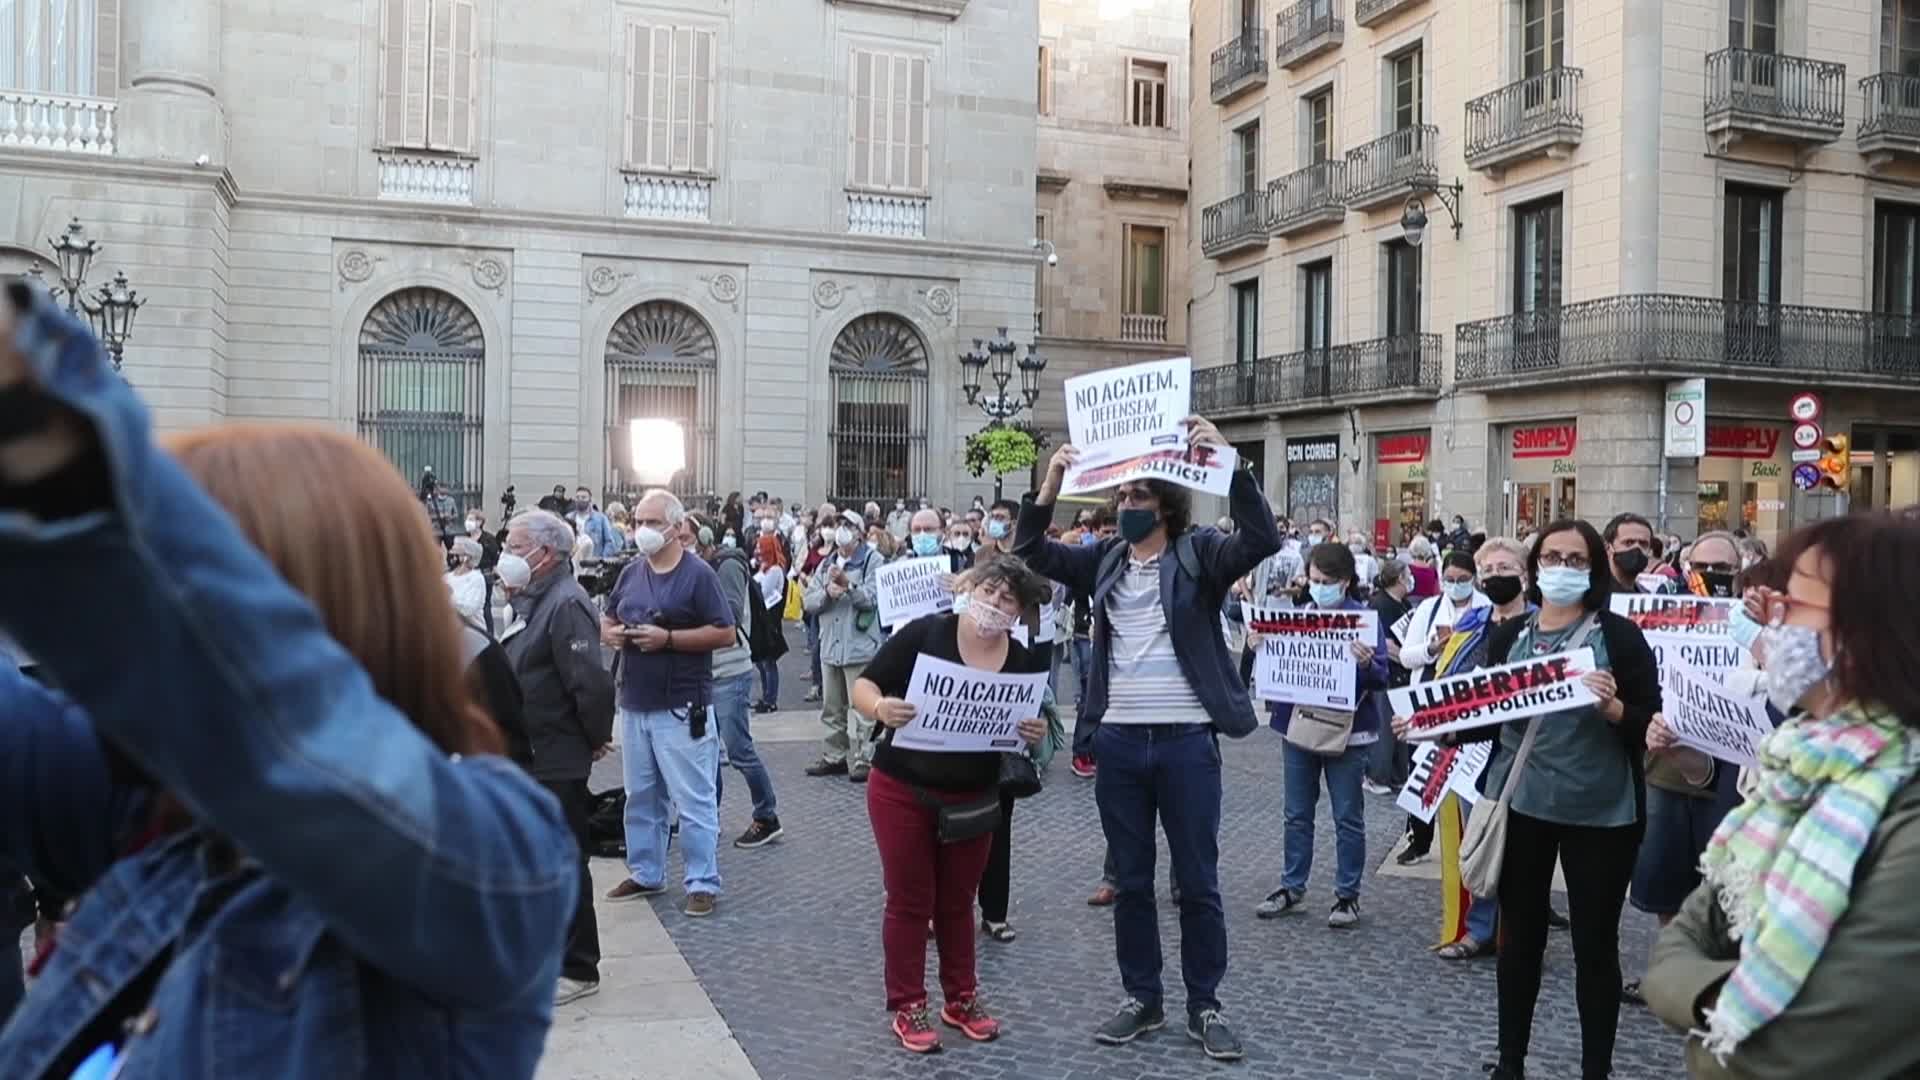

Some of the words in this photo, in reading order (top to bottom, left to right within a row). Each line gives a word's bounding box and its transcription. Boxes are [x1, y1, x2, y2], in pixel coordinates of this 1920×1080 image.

[1075, 386, 1098, 411] NO
[1091, 398, 1157, 425] DEFENSEM
[1085, 428, 1099, 445] LA
[1100, 413, 1165, 442] LLIBERTAT
[1287, 445, 1303, 461] BCN
[1304, 443, 1337, 461] CORNER
[1752, 461, 1782, 477] Basic
[880, 571, 895, 588] NO
[889, 598, 900, 609] LA
[1251, 608, 1362, 630] LLIBERTAT
[1266, 640, 1285, 656] NO
[1279, 659, 1332, 677] DEFENSEM
[923, 672, 954, 698] NO
[1272, 671, 1284, 684] LA
[1286, 673, 1337, 692] LLIBERTAT
[1409, 657, 1571, 712] LLIBERTAT
[1669, 664, 1684, 698] NO
[937, 699, 1012, 721] DEFENSEM
[1416, 706, 1481, 729] PRESOS
[922, 713, 939, 730] LA
[941, 717, 1014, 736] LLIBERTAT
